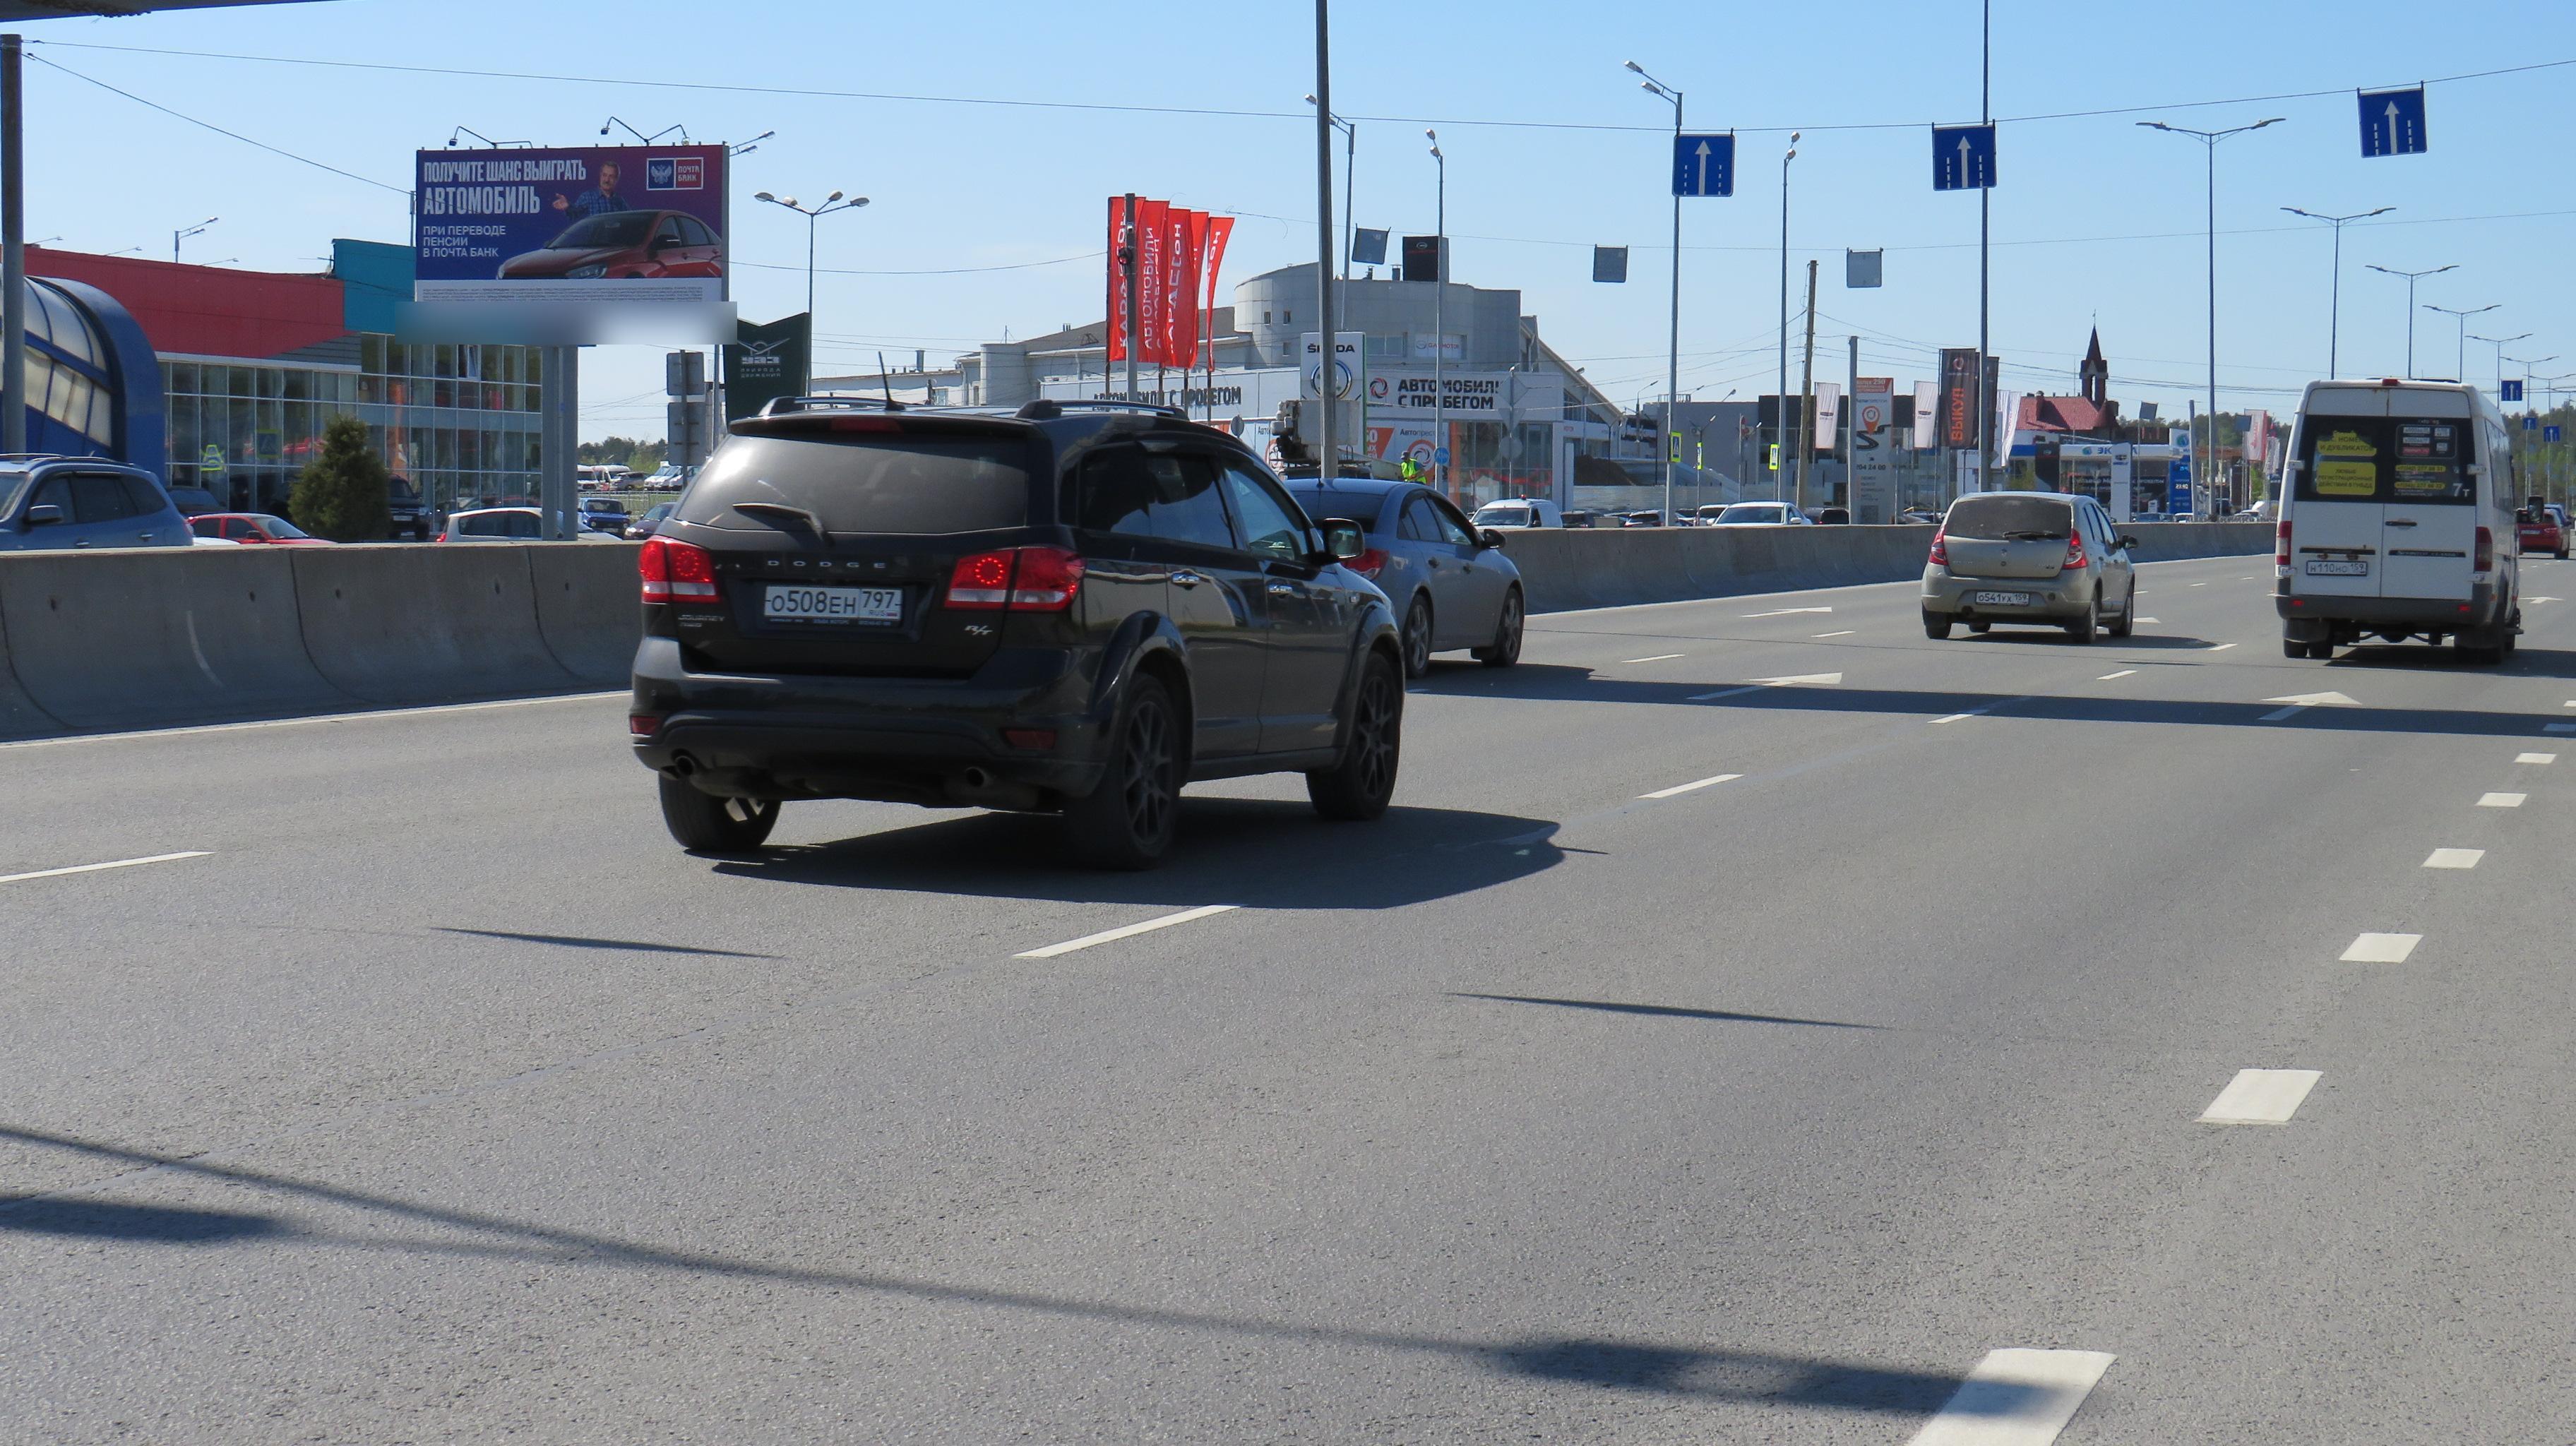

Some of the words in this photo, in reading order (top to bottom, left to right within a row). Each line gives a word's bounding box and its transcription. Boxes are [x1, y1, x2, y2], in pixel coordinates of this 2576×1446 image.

[423, 161, 484, 182] ПОЛУЧИТЕ
[487, 160, 522, 181] ШАНС
[524, 160, 587, 181] ВЫИГРАТЬ
[423, 186, 541, 215] АВТОМОБИЛЬ
[423, 226, 446, 235] ПРИ
[448, 225, 507, 237] ПЕРЕВОДЕ
[423, 237, 468, 246] ПЕНСИИ
[423, 248, 430, 257] В
[433, 248, 467, 257] ПОЧТА
[470, 247, 499, 257] БАНК
[1143, 227, 1155, 349] АВТОМОБИЛИ
[1307, 343, 1355, 353] ŠDA
[1398, 395, 1407, 407] С
[1951, 388, 1964, 441] ВЫКУП
[771, 590, 856, 614] О508ЕН
[862, 591, 895, 609] 797
